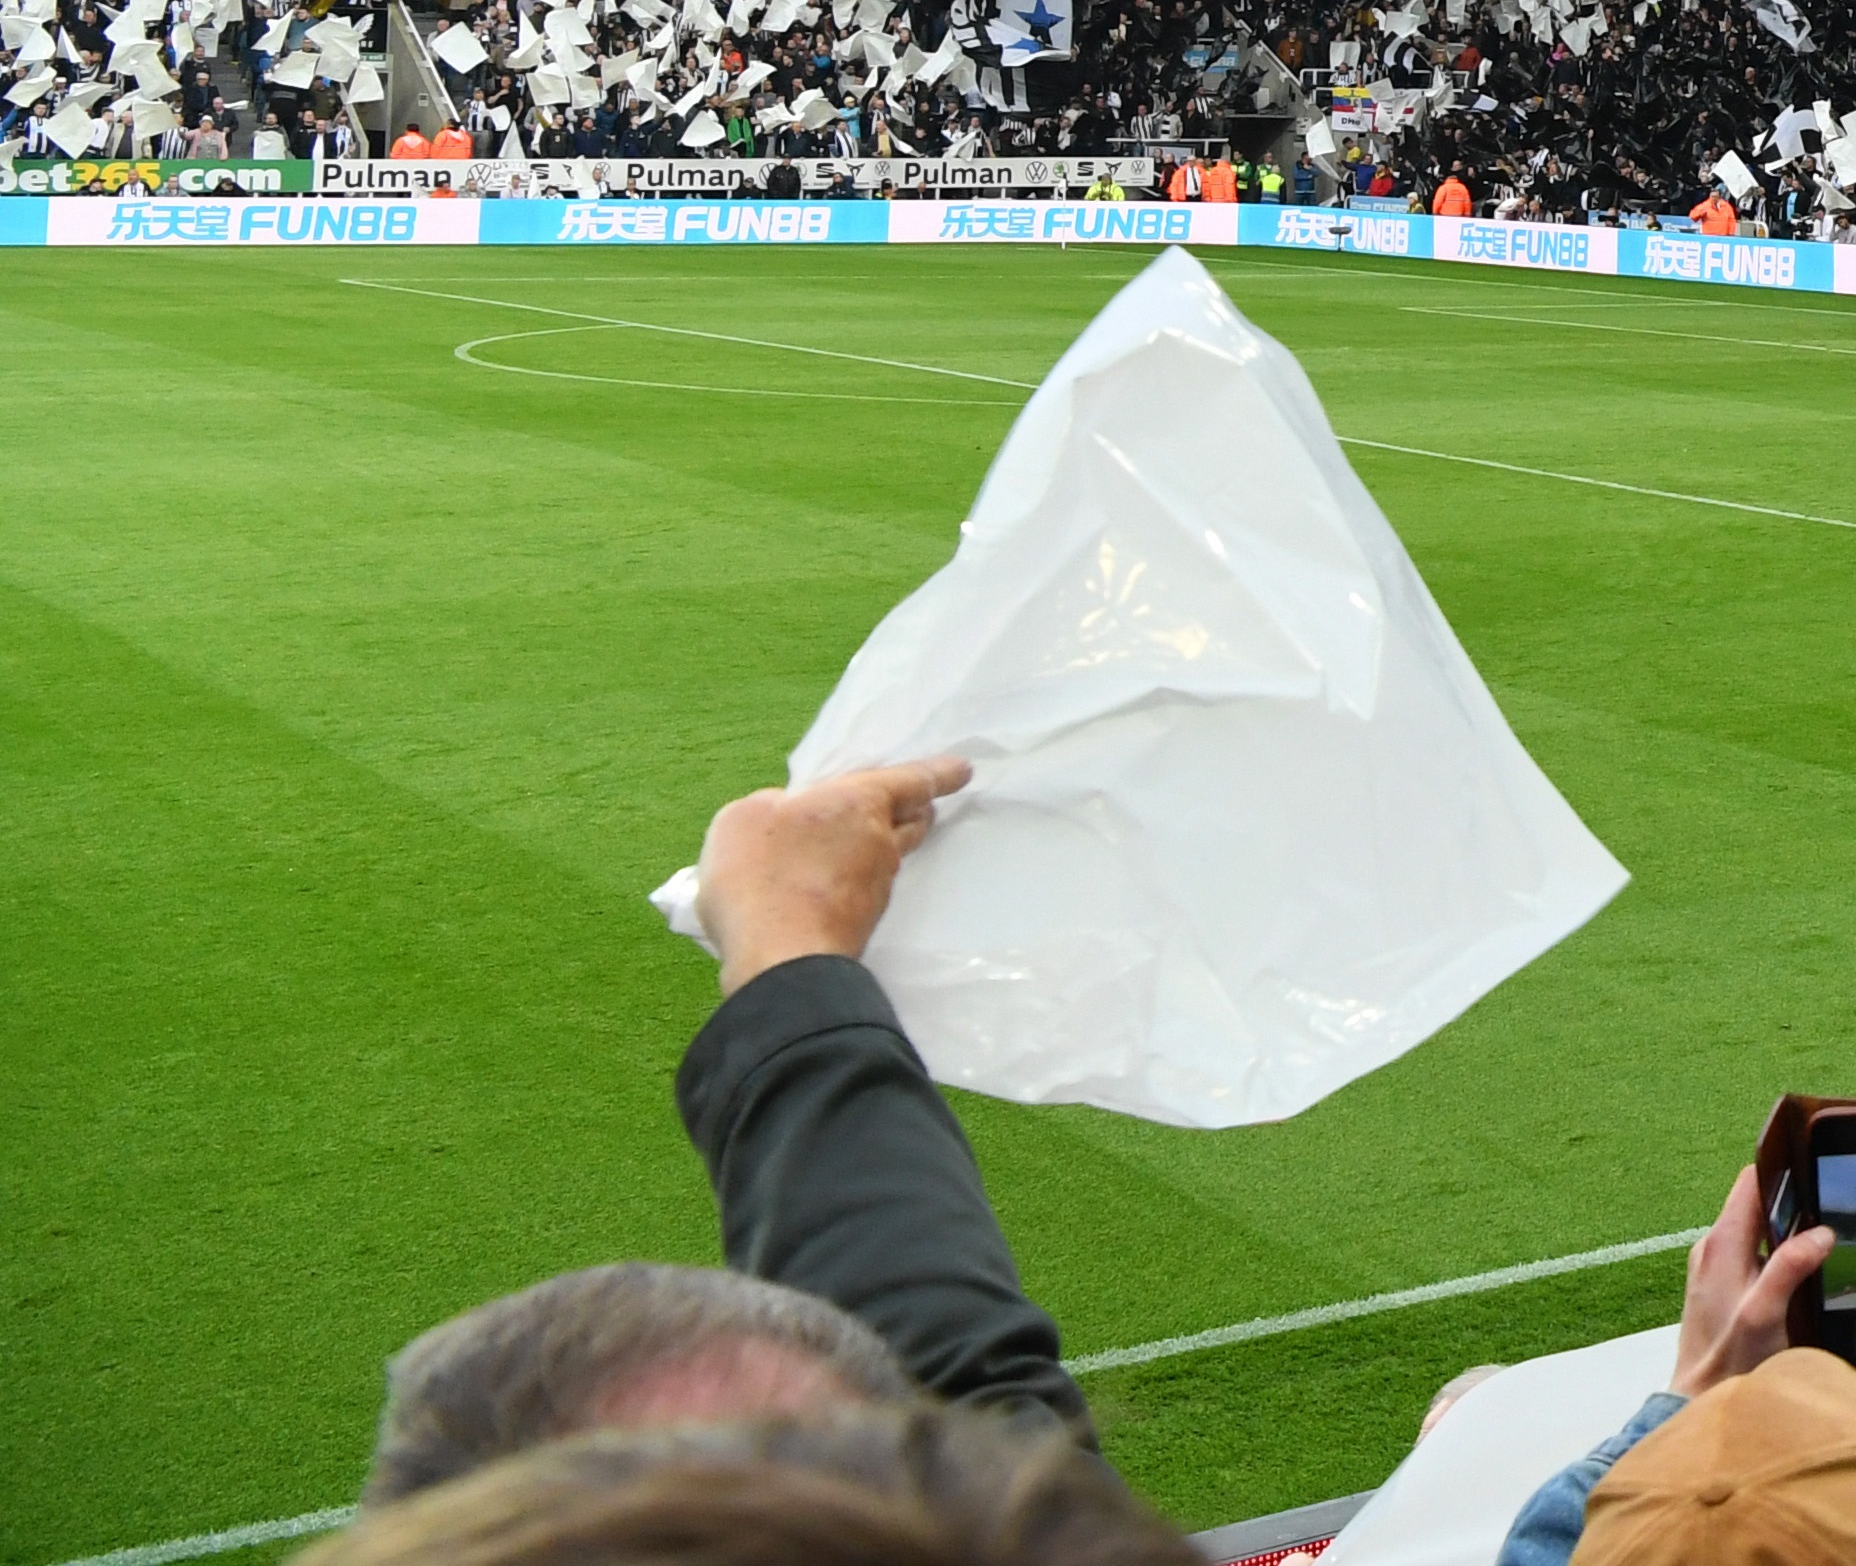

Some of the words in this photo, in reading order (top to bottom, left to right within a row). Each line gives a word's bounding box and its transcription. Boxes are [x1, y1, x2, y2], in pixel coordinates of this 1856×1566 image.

[323, 163, 450, 190] Pulman
[627, 163, 745, 190] Pulman
[905, 161, 1012, 186] Pulman
[106, 201, 230, 240] 乐天堂
[240, 205, 417, 241] FUN88
[557, 202, 666, 240] 乐天堂
[673, 206, 832, 241] FUN88
[939, 204, 1035, 238] 乐天堂
[1043, 208, 1192, 241] FUN88
[1275, 209, 1336, 245] 乐天堂
[1339, 216, 1409, 254] FUN88
[1458, 222, 1506, 260] 乐天堂
[1511, 229, 1589, 268] FUN88
[1643, 235, 1700, 279] 乐天堂
[1704, 242, 1795, 287] FUN88
